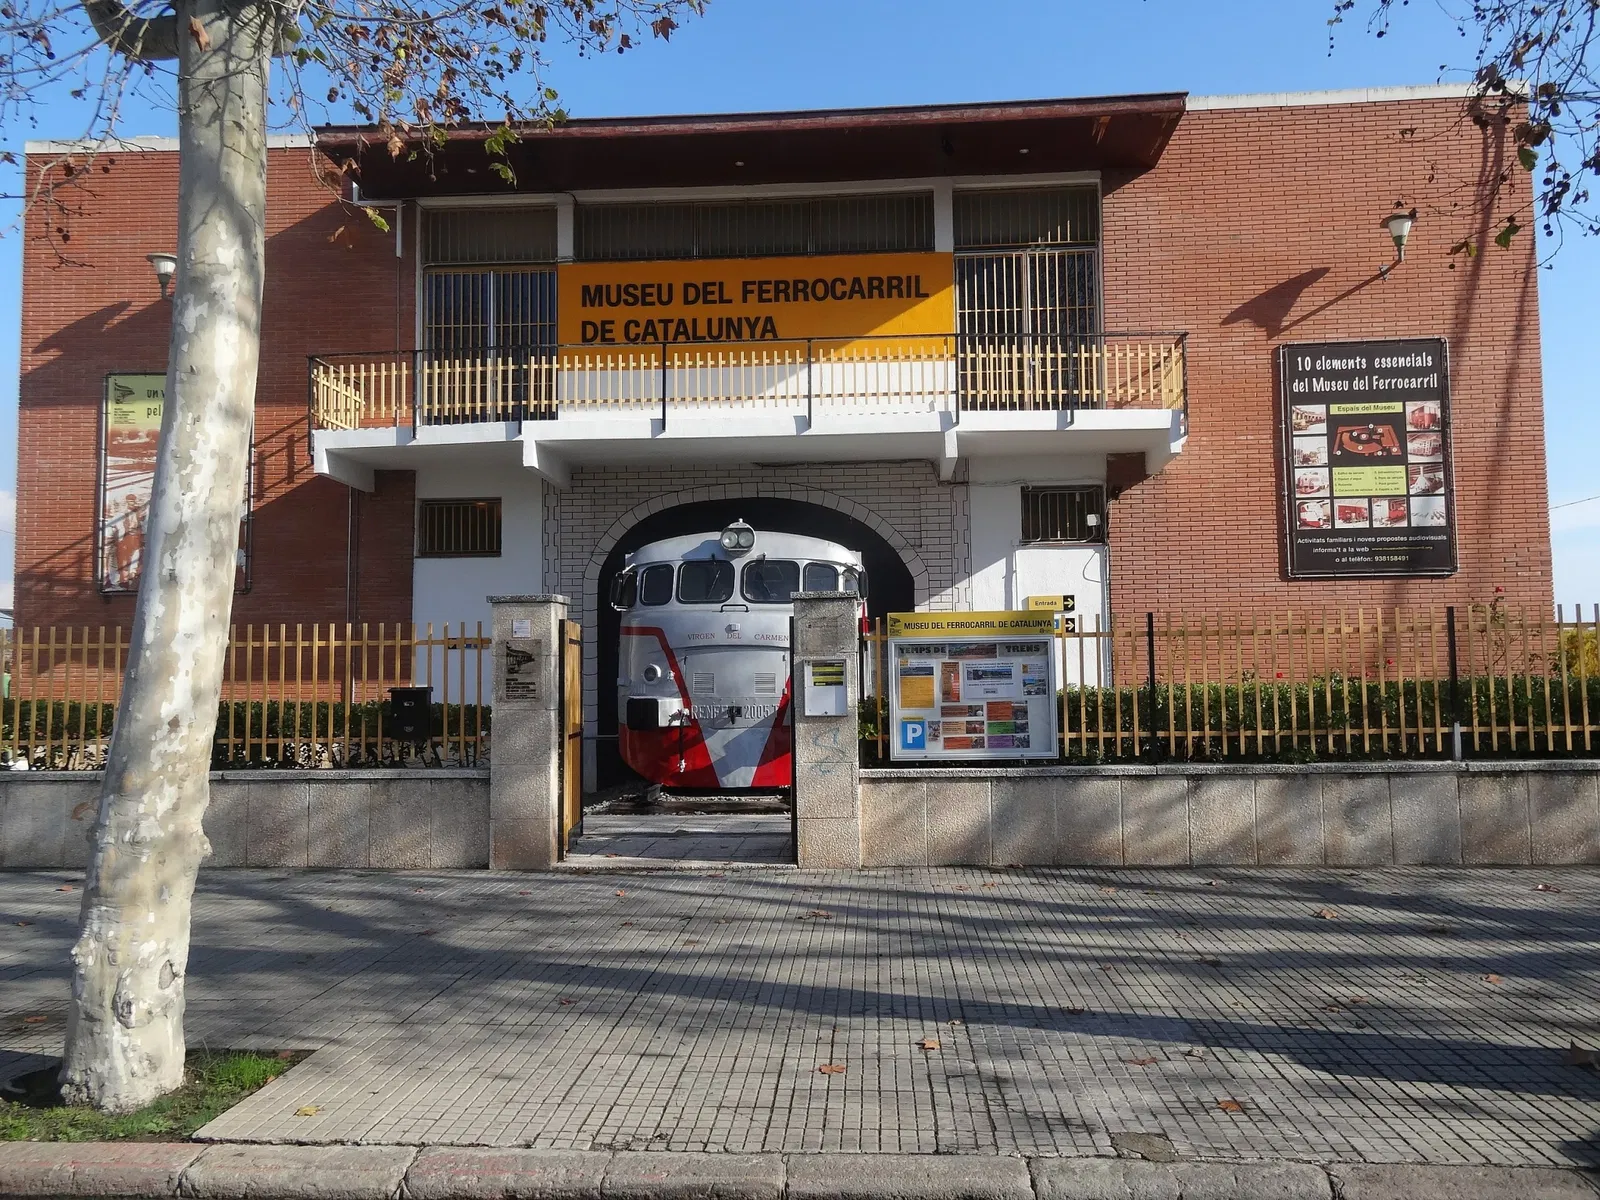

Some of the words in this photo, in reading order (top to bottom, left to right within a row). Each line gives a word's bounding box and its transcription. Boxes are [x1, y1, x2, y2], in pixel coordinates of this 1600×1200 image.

[581, 282, 674, 308] MUSEU
[683, 281, 733, 306] DEL
[741, 274, 930, 303] FERROCARRIL
[581, 319, 616, 343] DE
[623, 315, 779, 343] CATALUNYA
[1297, 356, 1312, 371] 10
[1315, 355, 1367, 370] elements
[1374, 352, 1433, 369] essencials
[1292, 378, 1309, 393] del
[1312, 377, 1349, 392] Museu
[1352, 375, 1369, 391] del
[1372, 373, 1438, 390] Ferrocarril
[1337, 405, 1360, 413] Espais
[1376, 535, 1408, 543] propostes
[903, 622, 930, 630] MUSEU
[931, 621, 946, 629] DEL
[946, 620, 997, 629] FERROCARRIL
[998, 620, 1009, 628] DE
[1010, 619, 1053, 628] CATALUNYA
[726, 632, 742, 640] DEL
[754, 633, 789, 641] CARMEN
[933, 646, 947, 654] DE
[1005, 644, 1040, 653] TRENS
[691, 704, 729, 719] RENFE
[907, 723, 923, 744] P
